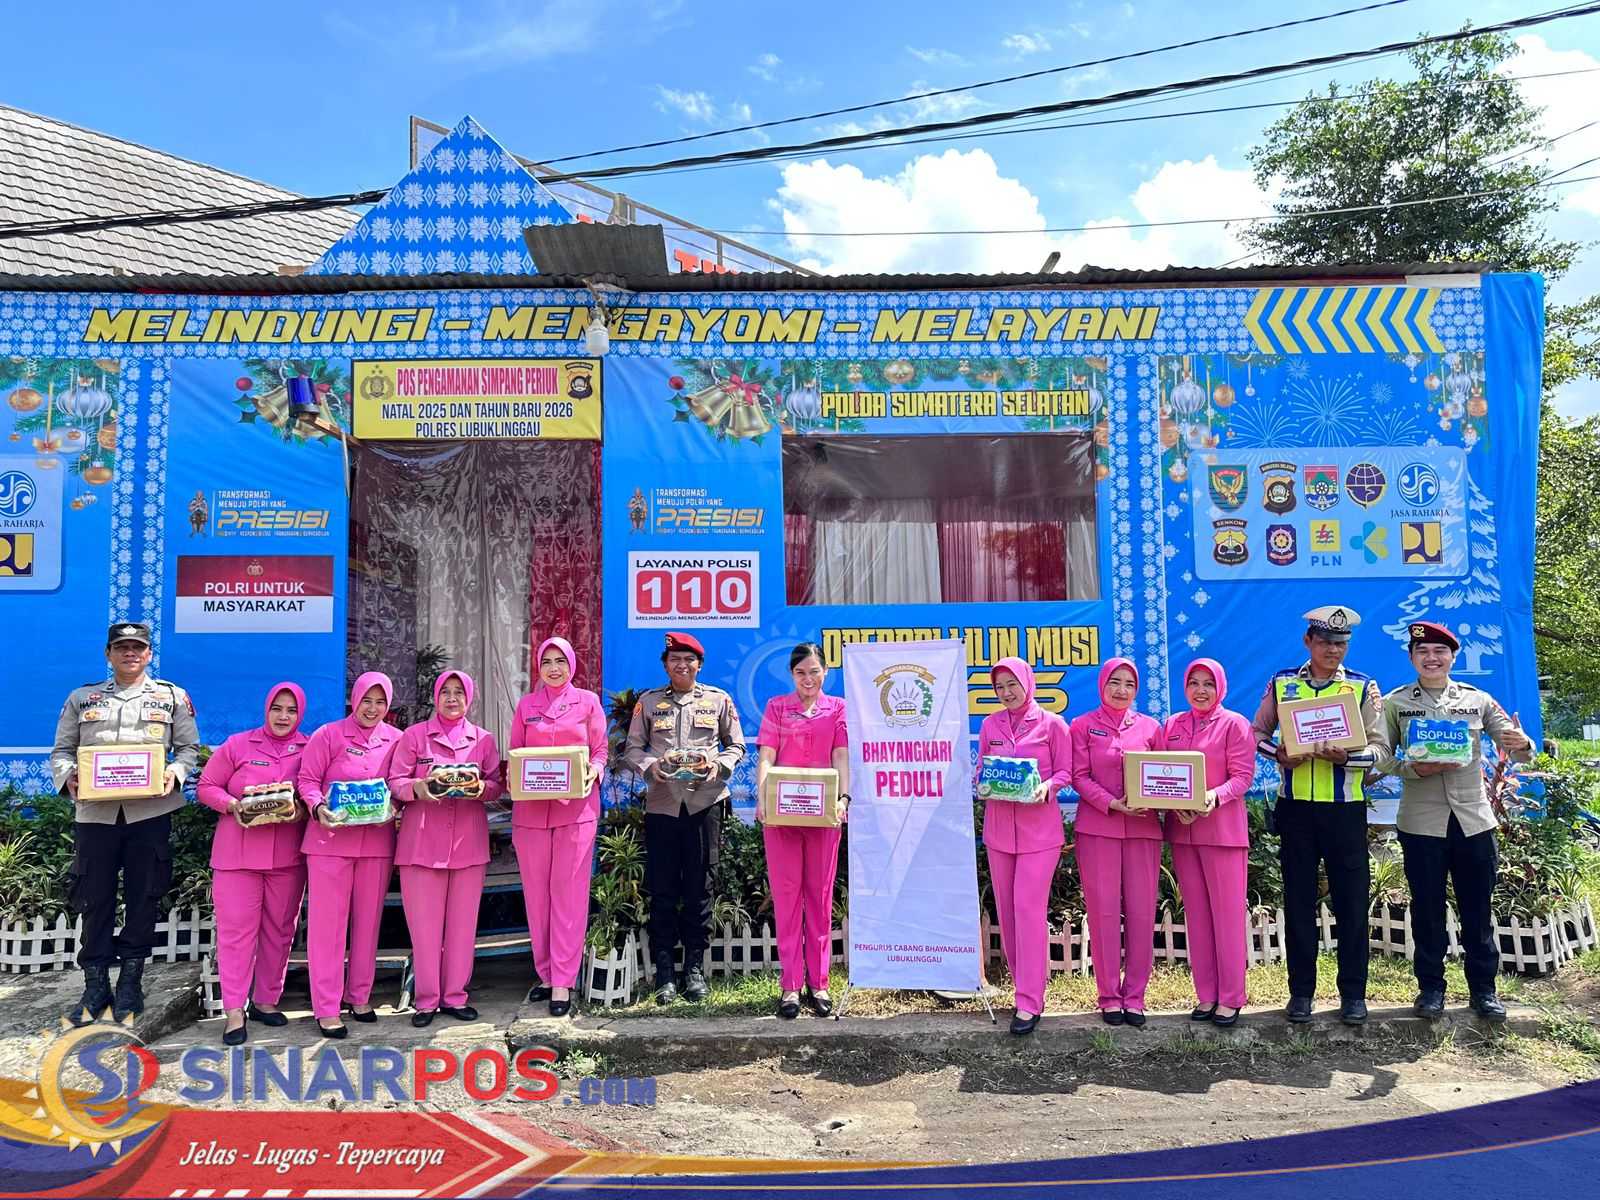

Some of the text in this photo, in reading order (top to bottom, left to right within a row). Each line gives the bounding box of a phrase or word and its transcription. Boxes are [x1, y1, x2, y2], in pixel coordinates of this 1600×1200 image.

[83, 308, 435, 343] MELINDUNGI
[871, 306, 1161, 343] MELAYANI
[397, 367, 559, 396] POS PENGAMANAN SIMPANG PERIUK
[821, 389, 1092, 418] POLDA SUMATERA SELATAN
[382, 403, 573, 419] NATAL 2025 DAN TAHUN BARU 2026
[416, 421, 541, 438] POLRES LUBUKLINGGAU
[218, 490, 271, 499] TRANSFORMASI
[656, 488, 708, 497] TRANSFORMASI
[218, 500, 287, 508] MENUJU POLRI YANG
[656, 498, 685, 506] MENUJU
[217, 510, 331, 529] PRESISI
[656, 508, 765, 527] PRESISI
[1391, 509, 1451, 518] JASA RAHARJA
[4, 520, 45, 528] RAHARJA
[636, 560, 752, 568] LAYANAN POLISI
[1311, 555, 1342, 566] PLN
[204, 582, 305, 594] POLRI UNTUK
[639, 574, 749, 611] 110
[203, 600, 306, 612] MASYARAKAT
[1026, 625, 1099, 666] MUSI
[143, 701, 173, 712] POLRI
[1416, 729, 1464, 741] ISOPLUS
[862, 740, 953, 763] BHAYANGKARI
[981, 767, 1022, 781] ISOPLUS
[875, 770, 944, 798] PEDULI
[338, 791, 384, 804] ISOPLUS
[854, 943, 977, 954] PENGURUS CABANG BHAYANGKARI
[887, 955, 943, 963] LUBUKLINGGAU
